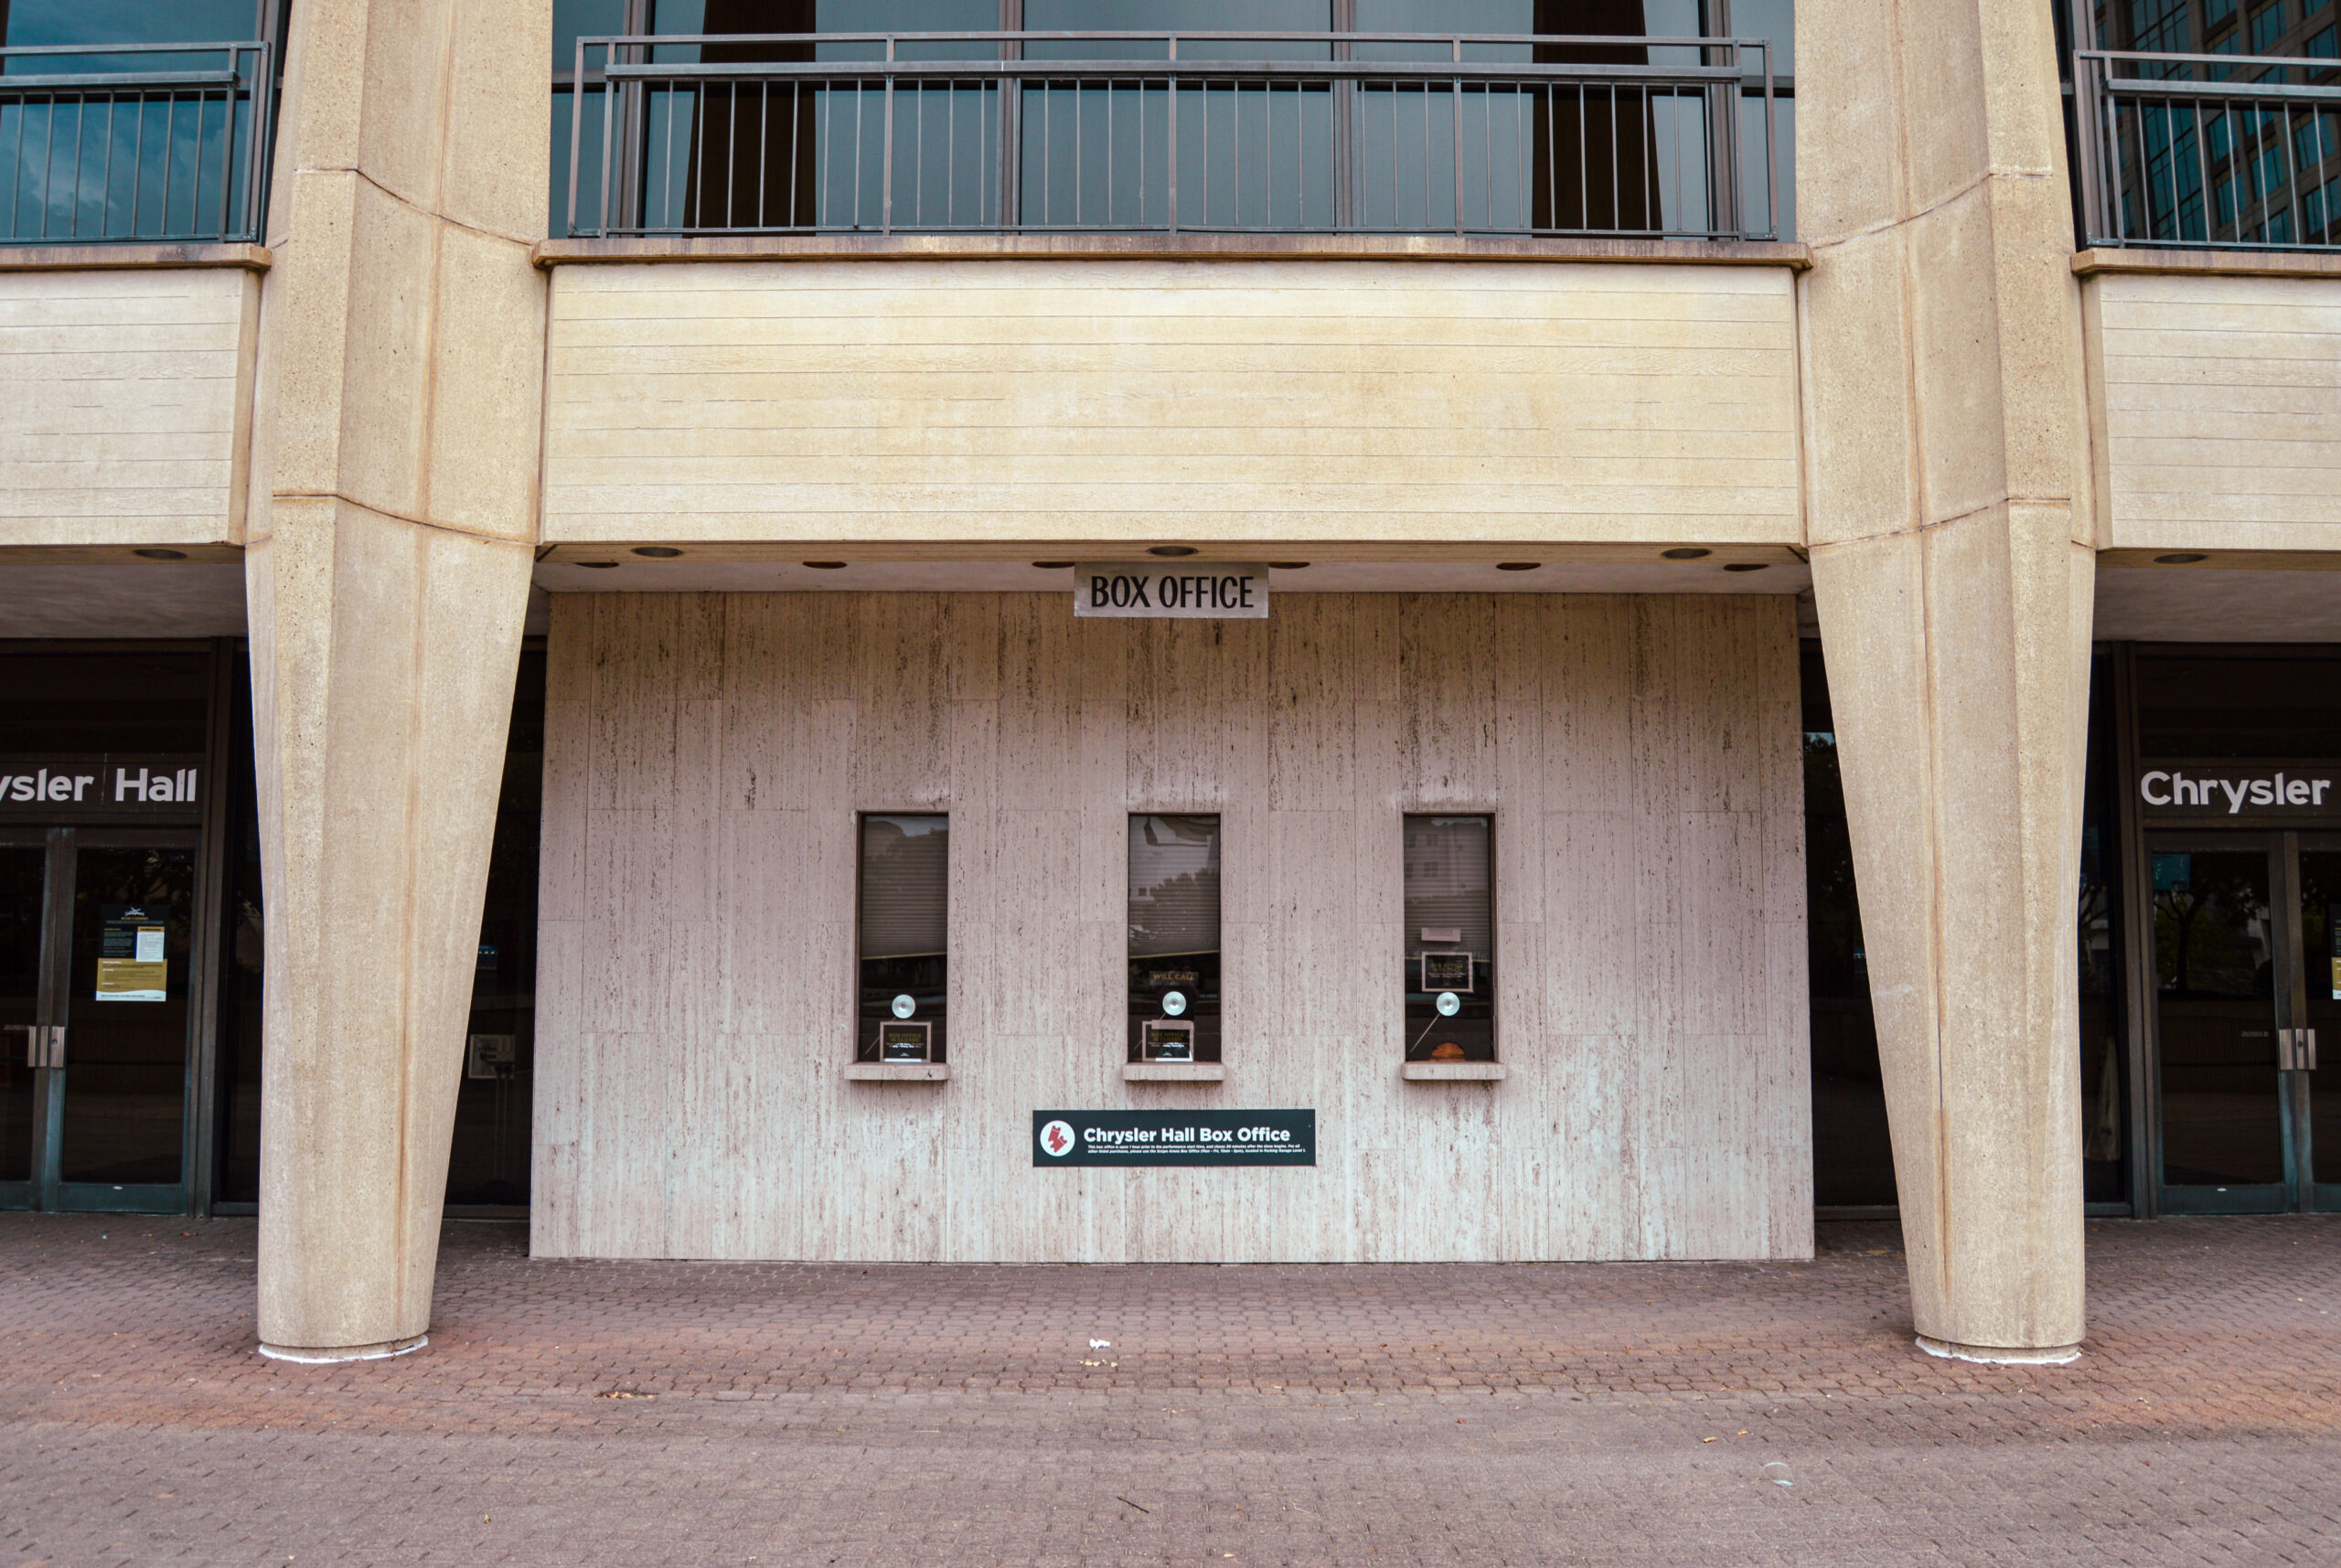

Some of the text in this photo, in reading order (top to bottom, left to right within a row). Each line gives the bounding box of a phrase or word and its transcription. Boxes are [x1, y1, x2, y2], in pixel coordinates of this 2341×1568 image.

[1091, 575, 1254, 609] BOX OFFICE
[115, 768, 197, 802] Hall
[2141, 771, 2331, 814] Chrysler
[1153, 973, 1196, 981] WILL CALL
[1084, 1126, 1291, 1145] Chrysler Hall Box Office
